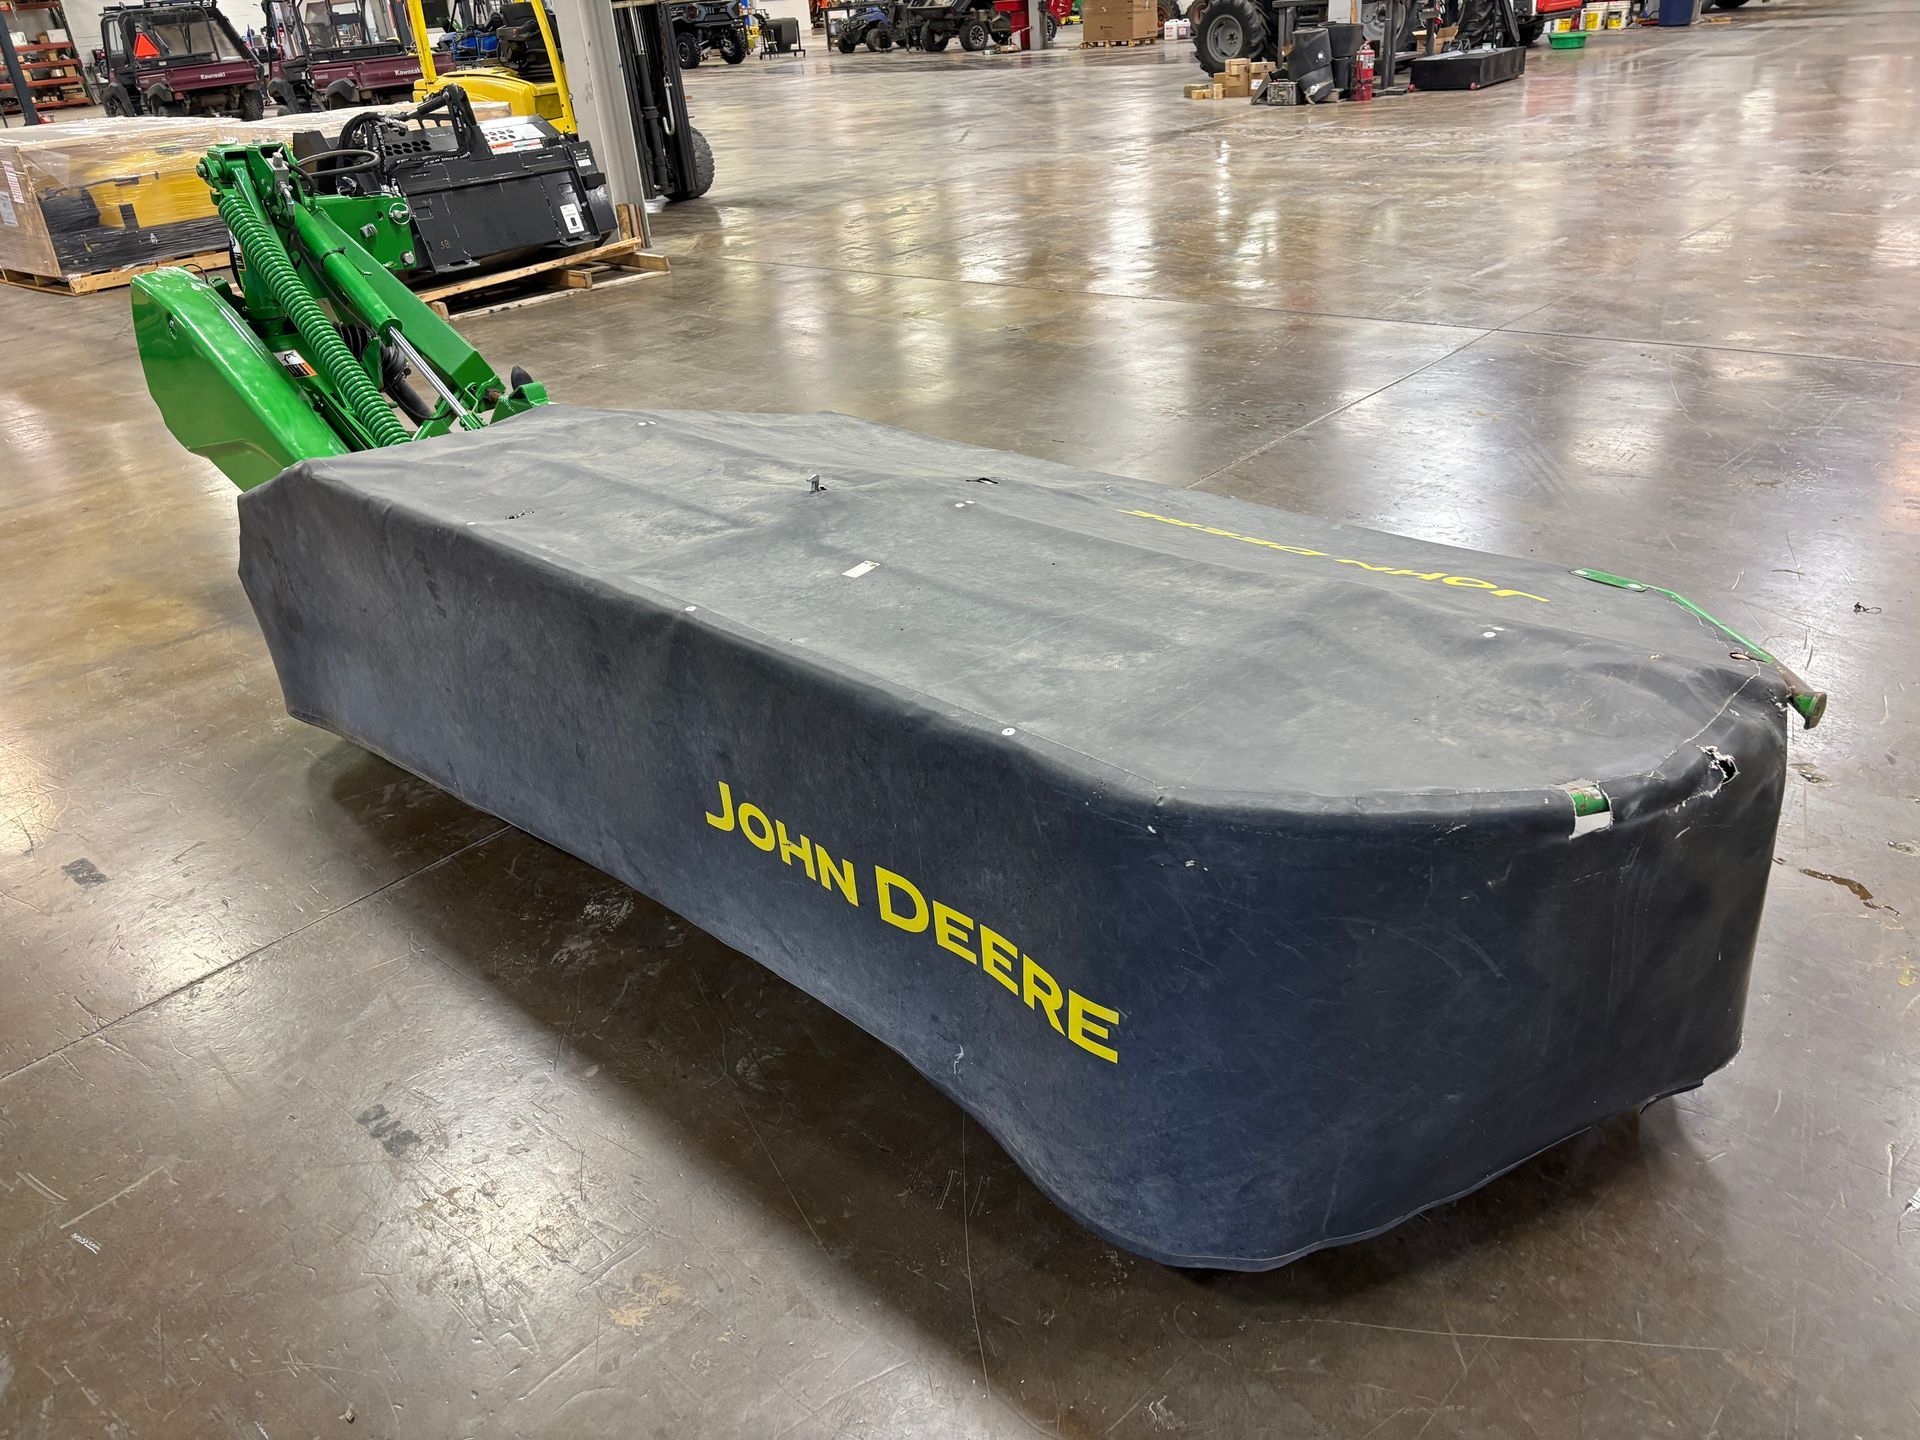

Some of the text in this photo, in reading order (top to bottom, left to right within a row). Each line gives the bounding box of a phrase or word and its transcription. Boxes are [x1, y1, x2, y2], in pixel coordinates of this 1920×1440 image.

[395, 67, 421, 76] Kawasak
[706, 780, 1120, 1064] JOHN DEERE
